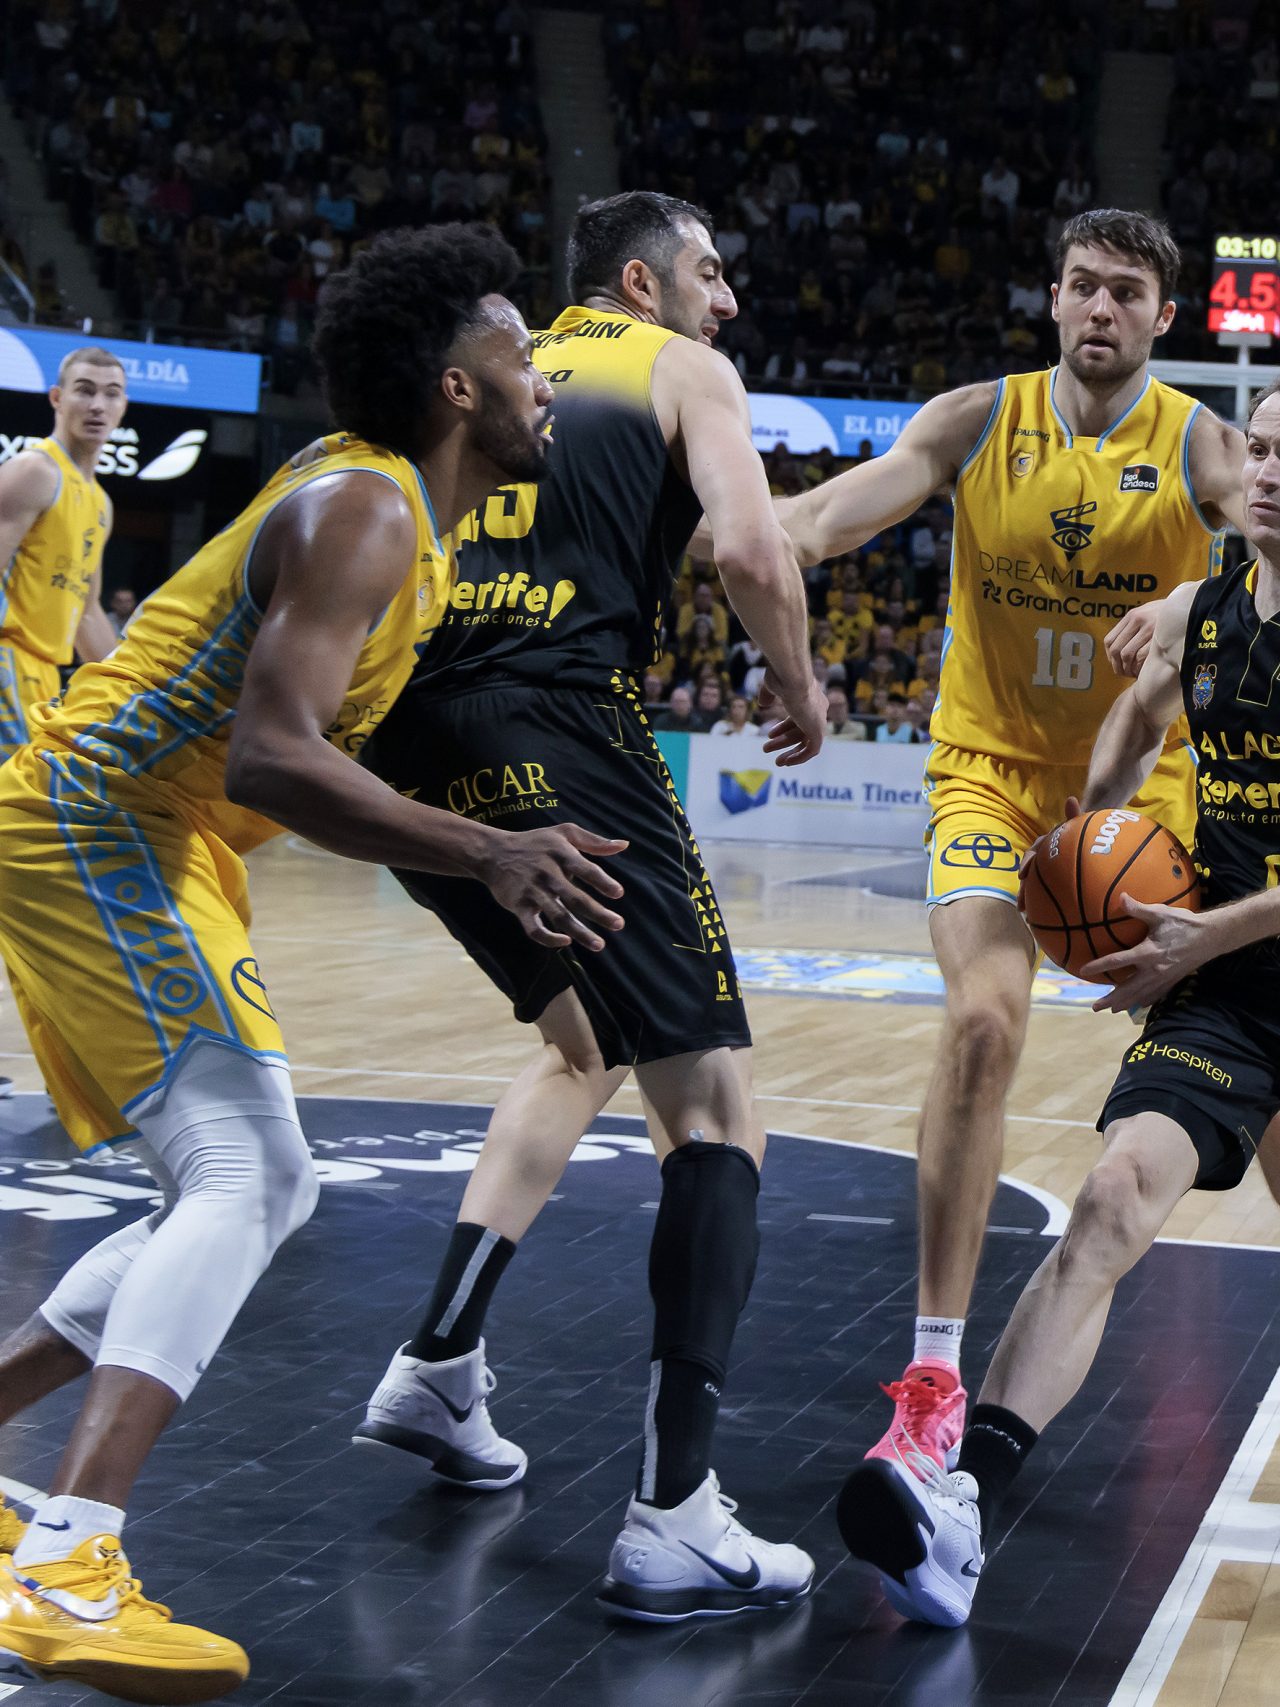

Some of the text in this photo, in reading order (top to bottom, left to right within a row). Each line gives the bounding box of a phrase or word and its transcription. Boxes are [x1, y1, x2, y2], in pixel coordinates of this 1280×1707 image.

[1216, 236, 1277, 259] 03:10
[1209, 269, 1276, 311] 4.5
[146, 358, 190, 384] DÍA
[844, 415, 872, 435] EL
[1122, 480, 1156, 489] endesa
[978, 551, 1158, 594] DREAMLAND
[449, 571, 577, 628] erife!
[1032, 627, 1095, 691] 18
[447, 762, 557, 816] CICAR
[777, 778, 926, 804] Mutua Tiner
[488, 797, 533, 818] Islands
[533, 795, 559, 809] Car
[1151, 1043, 1233, 1089] Hospiten
